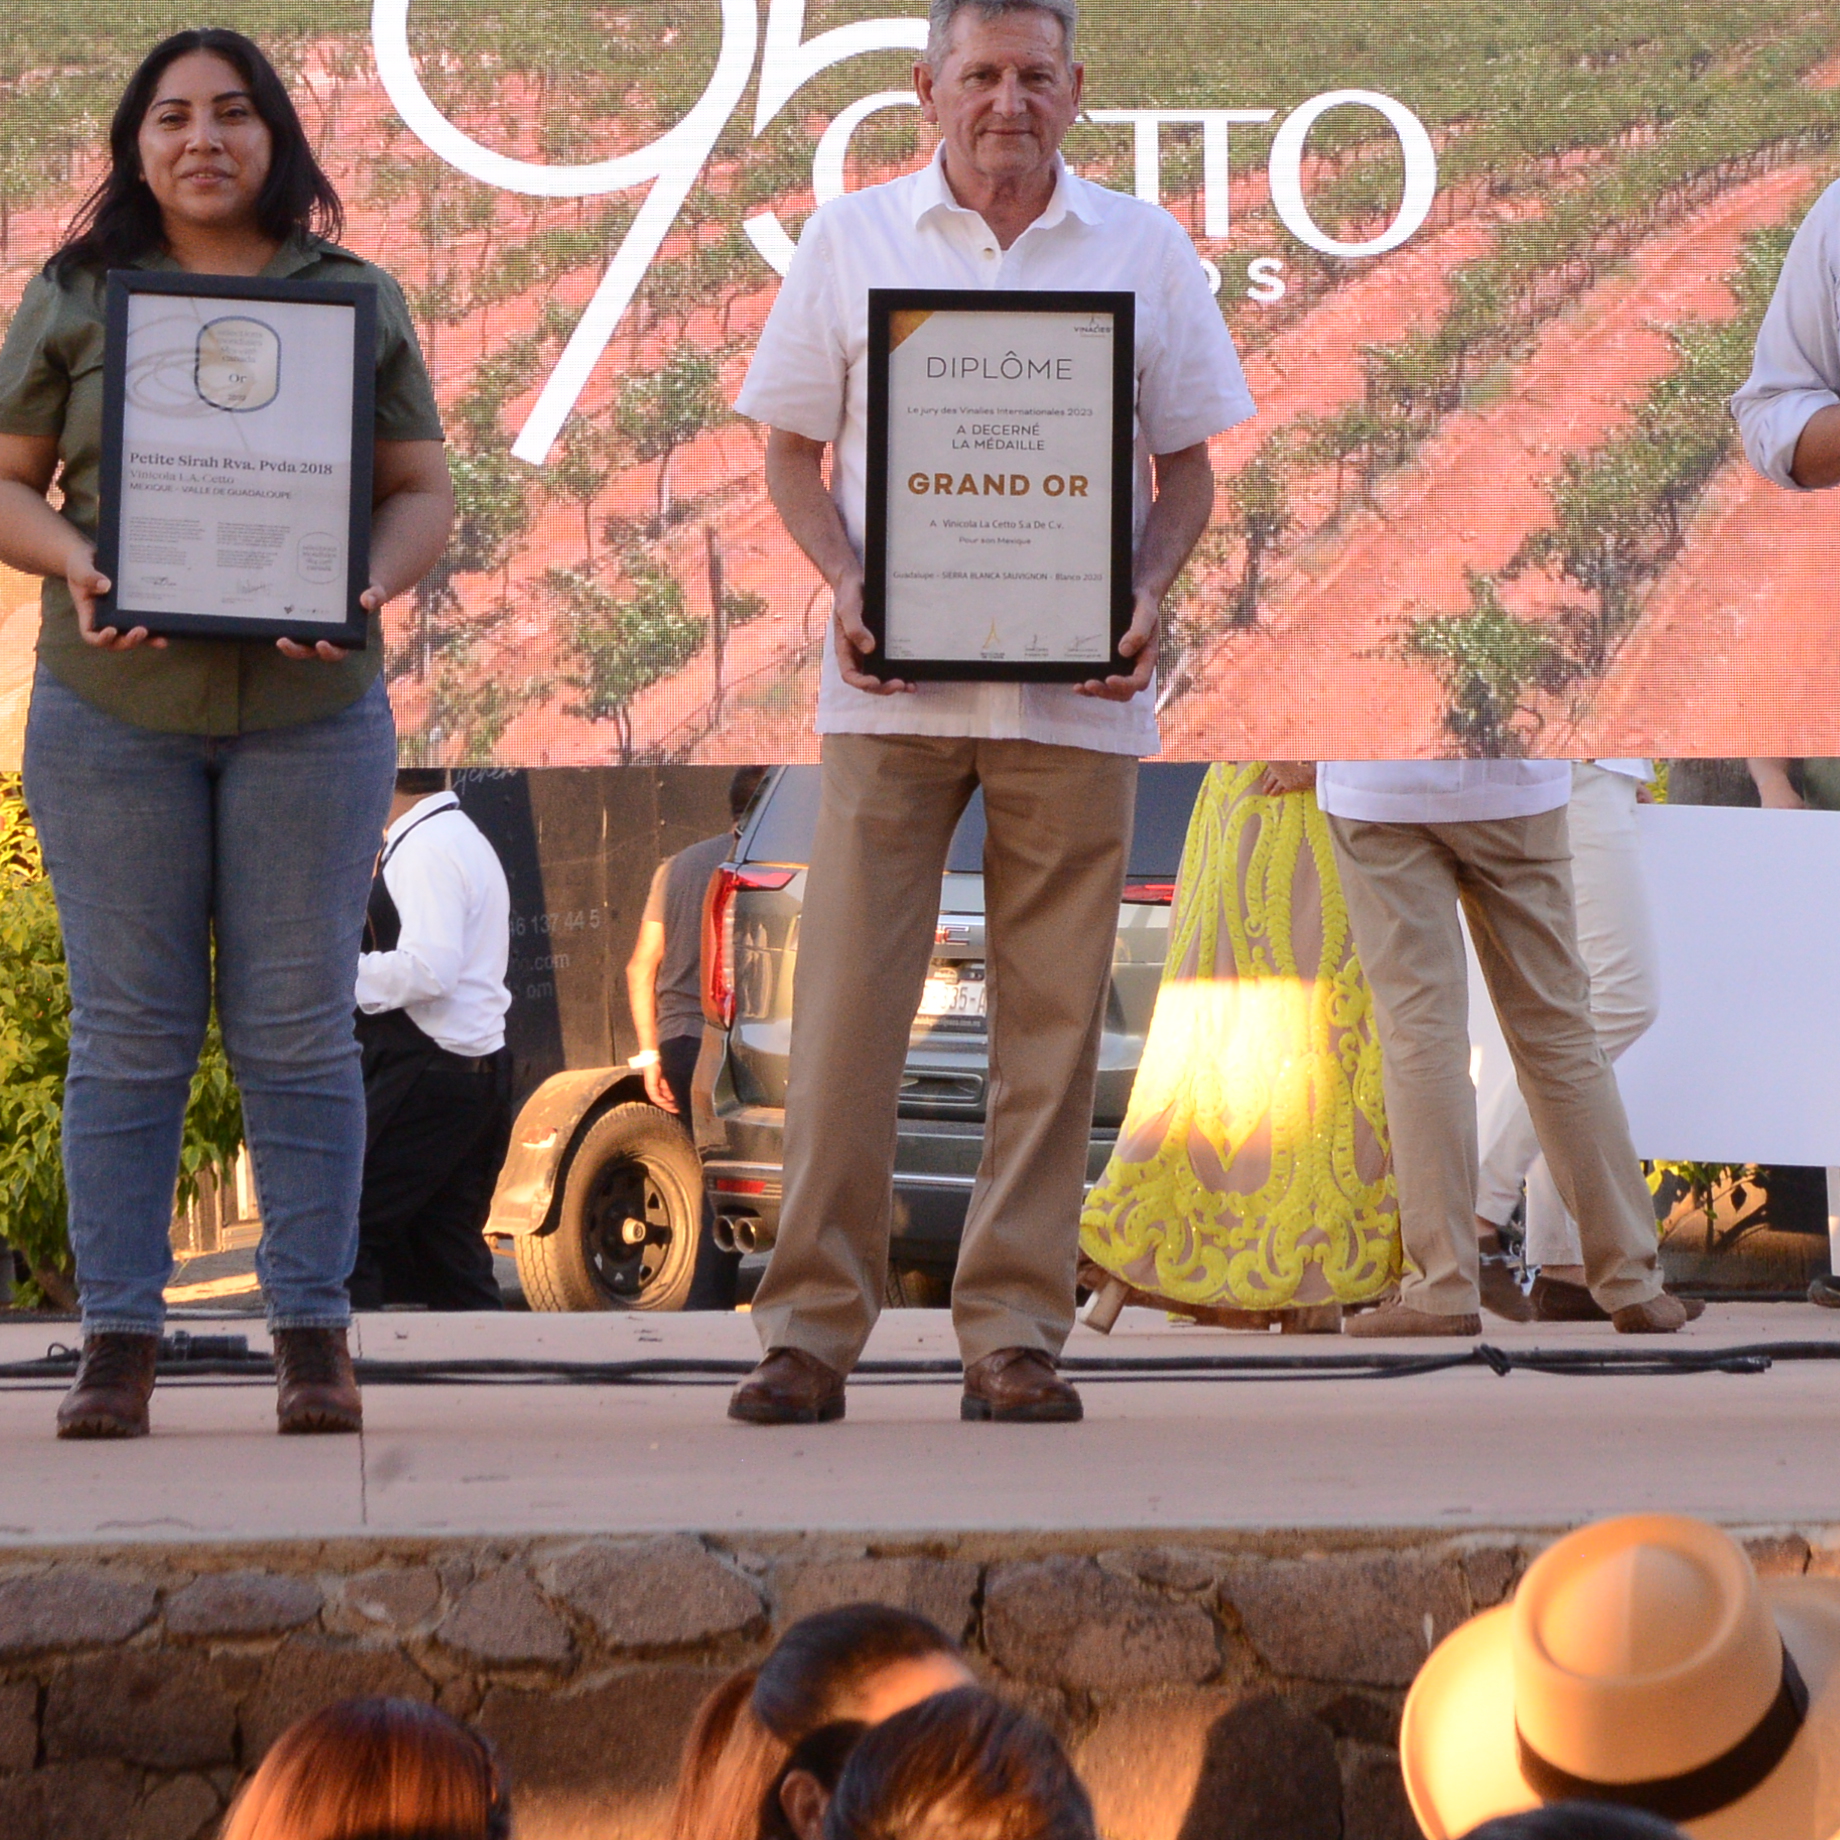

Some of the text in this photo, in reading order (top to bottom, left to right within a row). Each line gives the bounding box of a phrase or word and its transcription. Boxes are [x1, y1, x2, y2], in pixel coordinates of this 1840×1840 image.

[927, 350, 1073, 380] DIPLÔME
[229, 374, 247, 383] Or
[907, 406, 1093, 416] Le jury des Vinalies Internationales 2023
[956, 422, 1040, 436] A DECERNÉ
[952, 437, 1045, 451] LA MÉDAILLE
[129, 452, 333, 475] Petite Sirah Rva. Pvda 2018
[202, 473, 235, 485] Cetto
[908, 472, 1089, 497] GRAND OR
[129, 482, 173, 494] MEXIQUE
[181, 485, 210, 495] VALLE
[212, 487, 225, 496] DE
[227, 488, 291, 500] GUADALOUPE
[929, 520, 937, 528] A
[979, 520, 990, 529] La
[992, 520, 1016, 529] Cetto
[1034, 521, 1046, 529] De
[1048, 521, 1065, 530] C.v.
[959, 536, 1031, 546] Pour son Mexique
[893, 571, 934, 580] Guadalupe
[942, 571, 968, 580] SIERRA
[970, 572, 1000, 580] BLANCA
[1002, 572, 1048, 581] SAUVIGNON
[1055, 572, 1081, 581] Blanco
[1083, 573, 1103, 582] 2020
[531, 912, 560, 934] 137
[564, 910, 585, 931] 44
